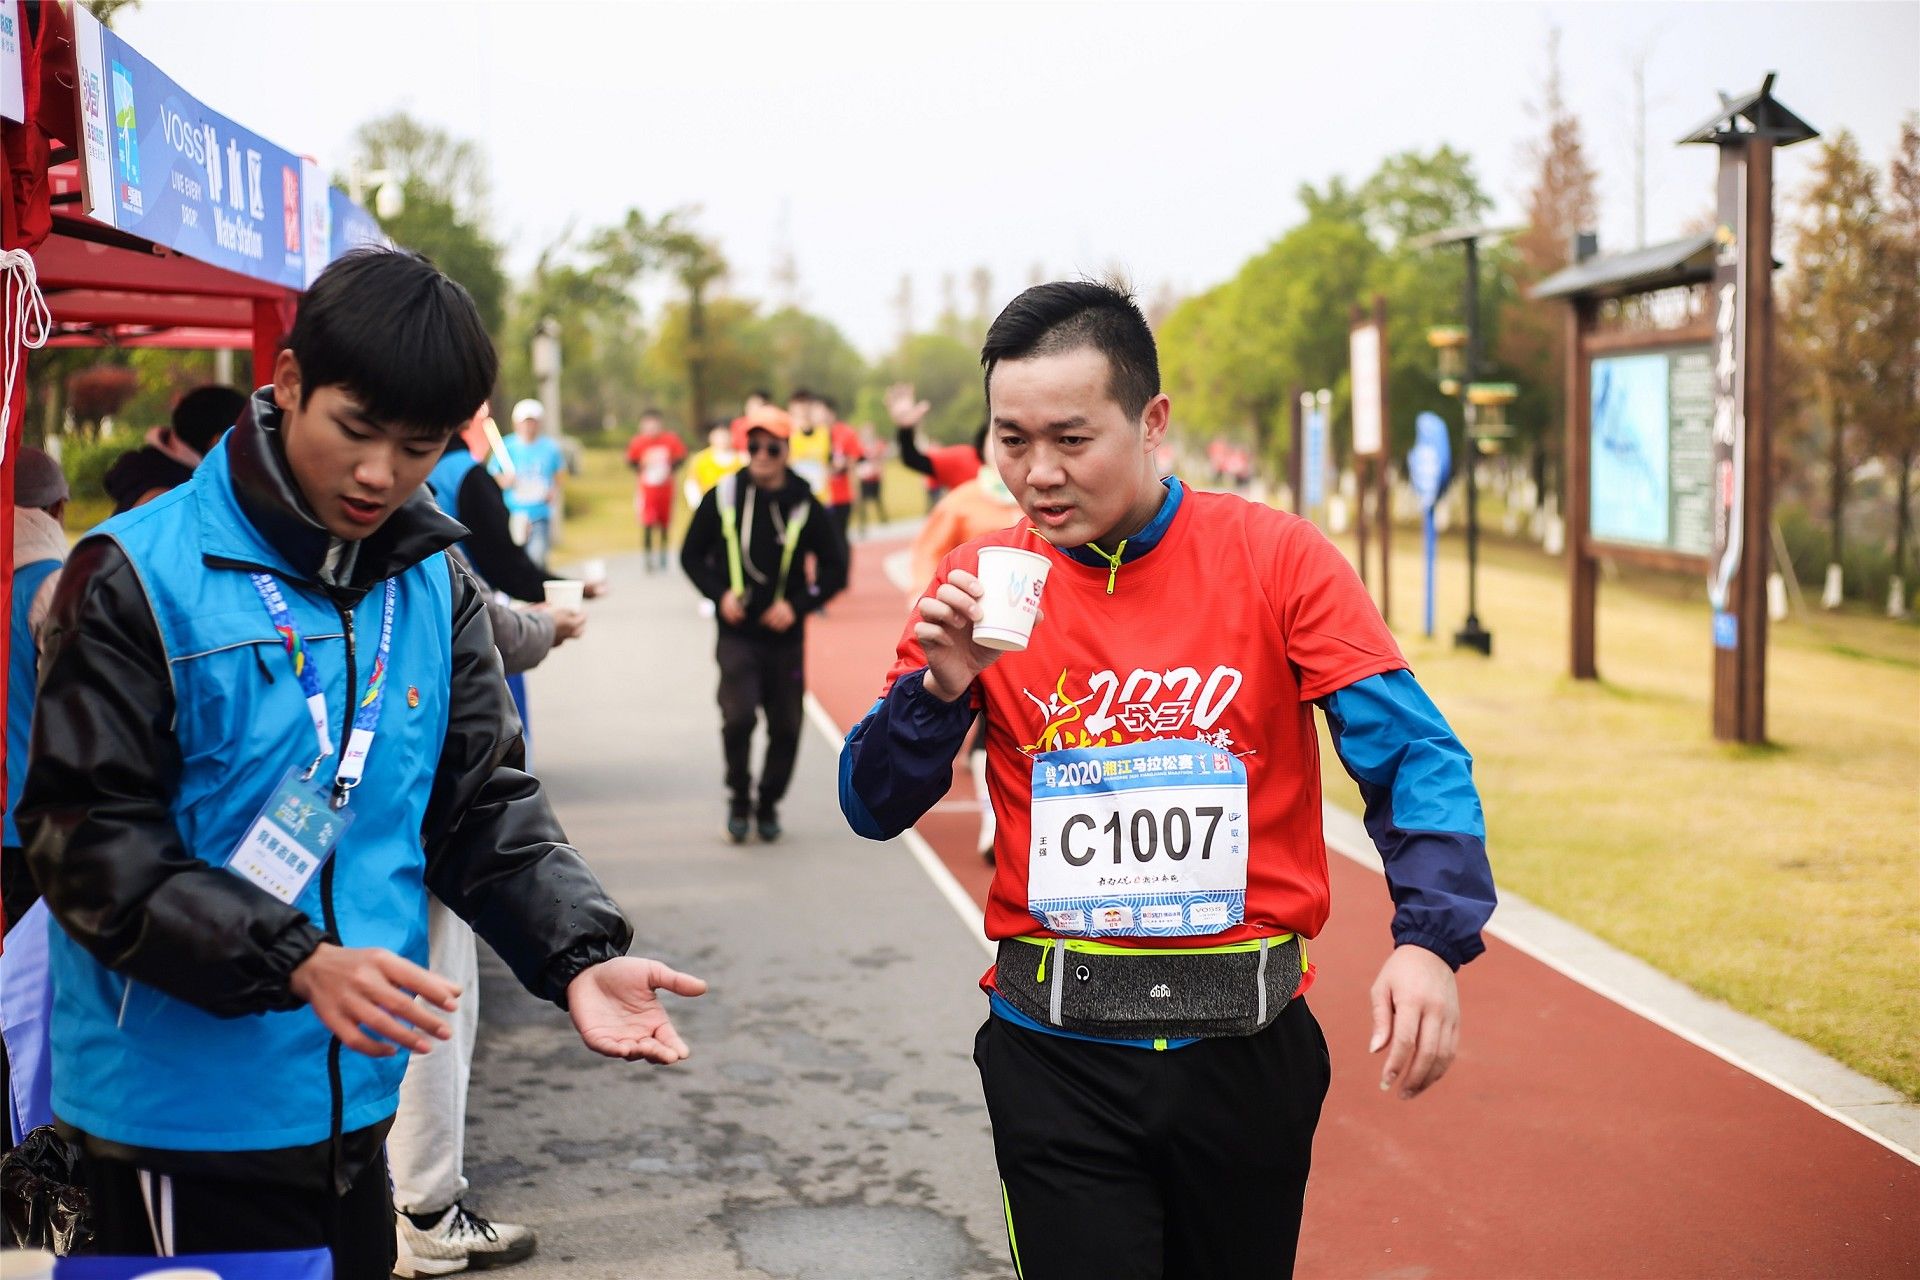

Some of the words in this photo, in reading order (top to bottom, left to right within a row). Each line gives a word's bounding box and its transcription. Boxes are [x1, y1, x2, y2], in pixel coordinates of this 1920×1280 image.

[160, 104, 204, 165] VOSS
[171, 170, 185, 193] LIVE
[213, 207, 238, 253] Water
[236, 214, 264, 261] Station
[1083, 665, 1243, 736] 2020
[1058, 759, 1102, 788] 2020
[1103, 754, 1193, 776] 湘江马拉松赛
[1060, 806, 1224, 867] C1007
